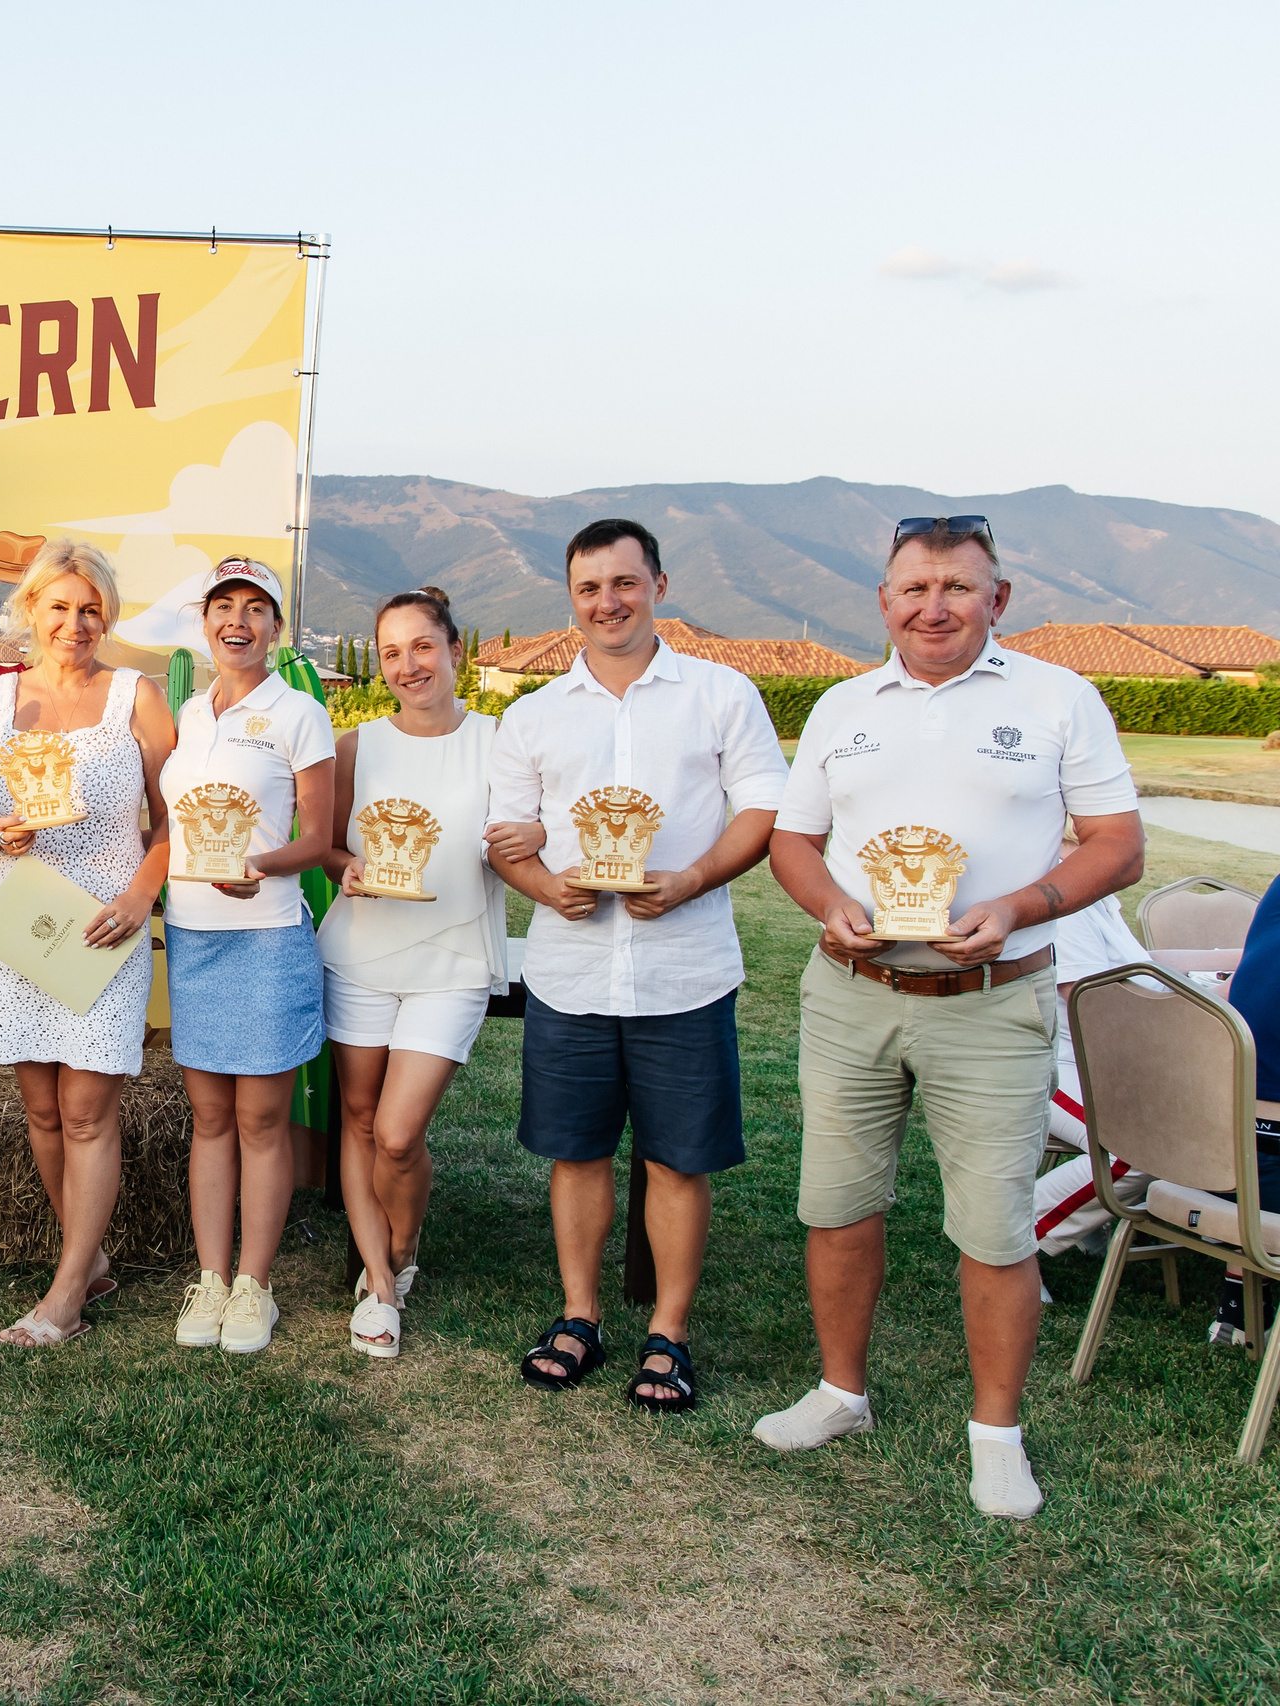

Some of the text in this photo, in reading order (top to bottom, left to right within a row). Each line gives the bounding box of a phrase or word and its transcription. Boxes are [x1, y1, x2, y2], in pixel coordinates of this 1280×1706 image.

[977, 748, 1036, 760] GELENDZHIK
[37, 782, 43, 792] 2
[174, 782, 262, 817] WESTERN
[569, 785, 665, 821] WESTERN
[27, 800, 60, 818] CUP
[355, 798, 443, 835] WESTERN
[204, 840, 229, 852] CUP
[613, 841, 617, 852] 1
[857, 825, 969, 865] WESTERN
[393, 851, 398, 861] 1
[377, 868, 411, 887] CUP
[595, 862, 633, 879] CUP
[897, 892, 929, 907] CUP
[43, 918, 75, 958] GELENDZHIK
